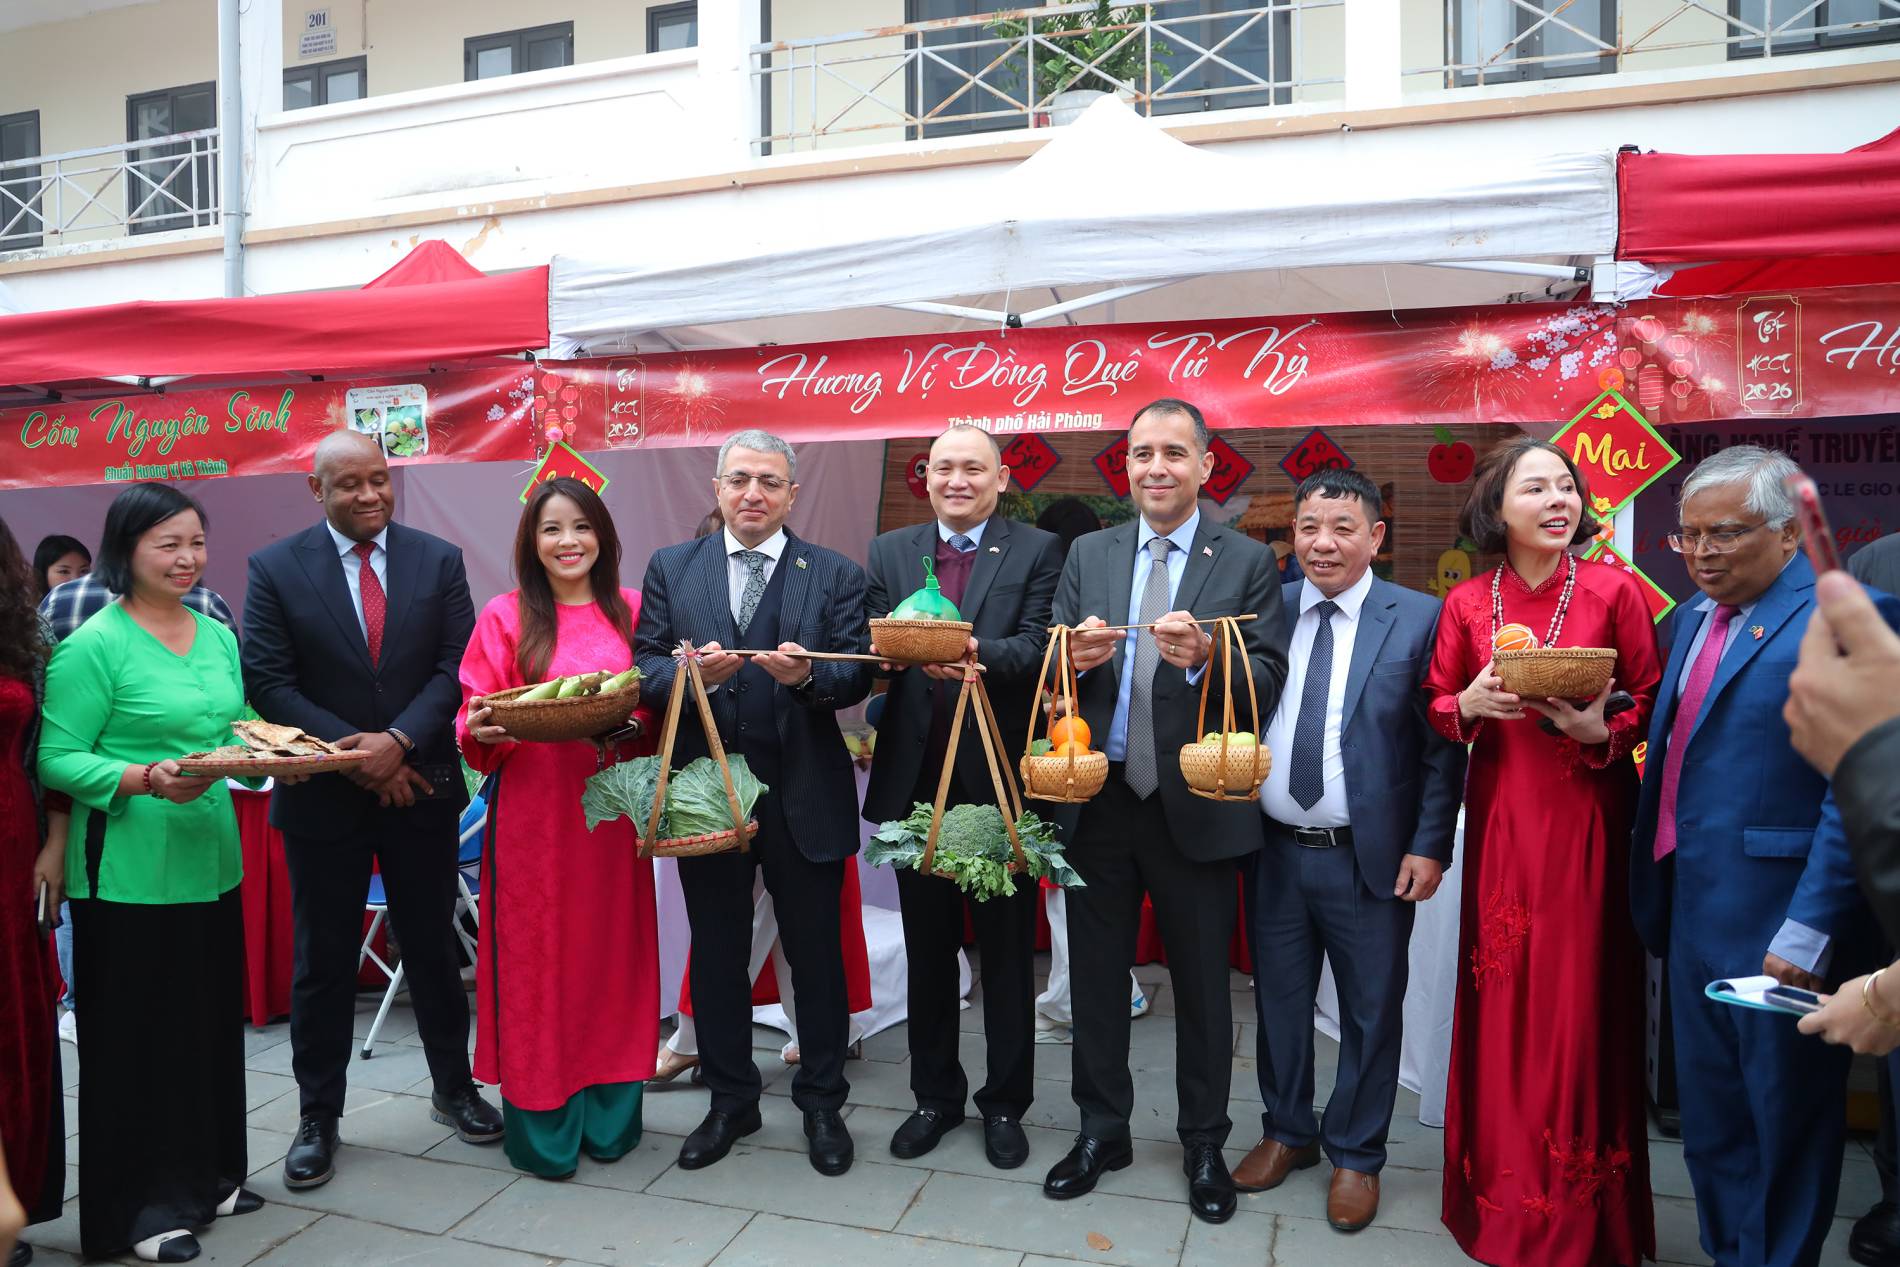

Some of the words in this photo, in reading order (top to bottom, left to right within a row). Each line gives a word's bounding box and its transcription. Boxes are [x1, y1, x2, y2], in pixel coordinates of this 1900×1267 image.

[309, 12, 326, 28] 201
[1753, 311, 1788, 343] Tết
[757, 353, 882, 413] Hương
[897, 342, 953, 399] Vị
[943, 341, 1047, 407] Đồng
[1062, 339, 1142, 396] Quê
[1147, 331, 1216, 383] Tứ
[1217, 318, 1322, 395] Kỳ
[1745, 382, 1792, 400] 2026
[21, 411, 79, 448] Cốm
[90, 400, 210, 457] Nguyên
[225, 388, 294, 433] Sinh
[608, 422, 639, 437] 2026
[995, 412, 1026, 432] phố
[1028, 411, 1050, 429] Hải
[1055, 411, 1103, 429] Phòng
[1573, 432, 1650, 476] Mai
[1669, 427, 1720, 464] ÀNG
[1809, 425, 1900, 464] TRUYỀ
[105, 461, 134, 480] Chuẩn
[136, 464, 168, 479] Hương
[181, 461, 195, 476] Hà
[196, 458, 228, 474] Thành
